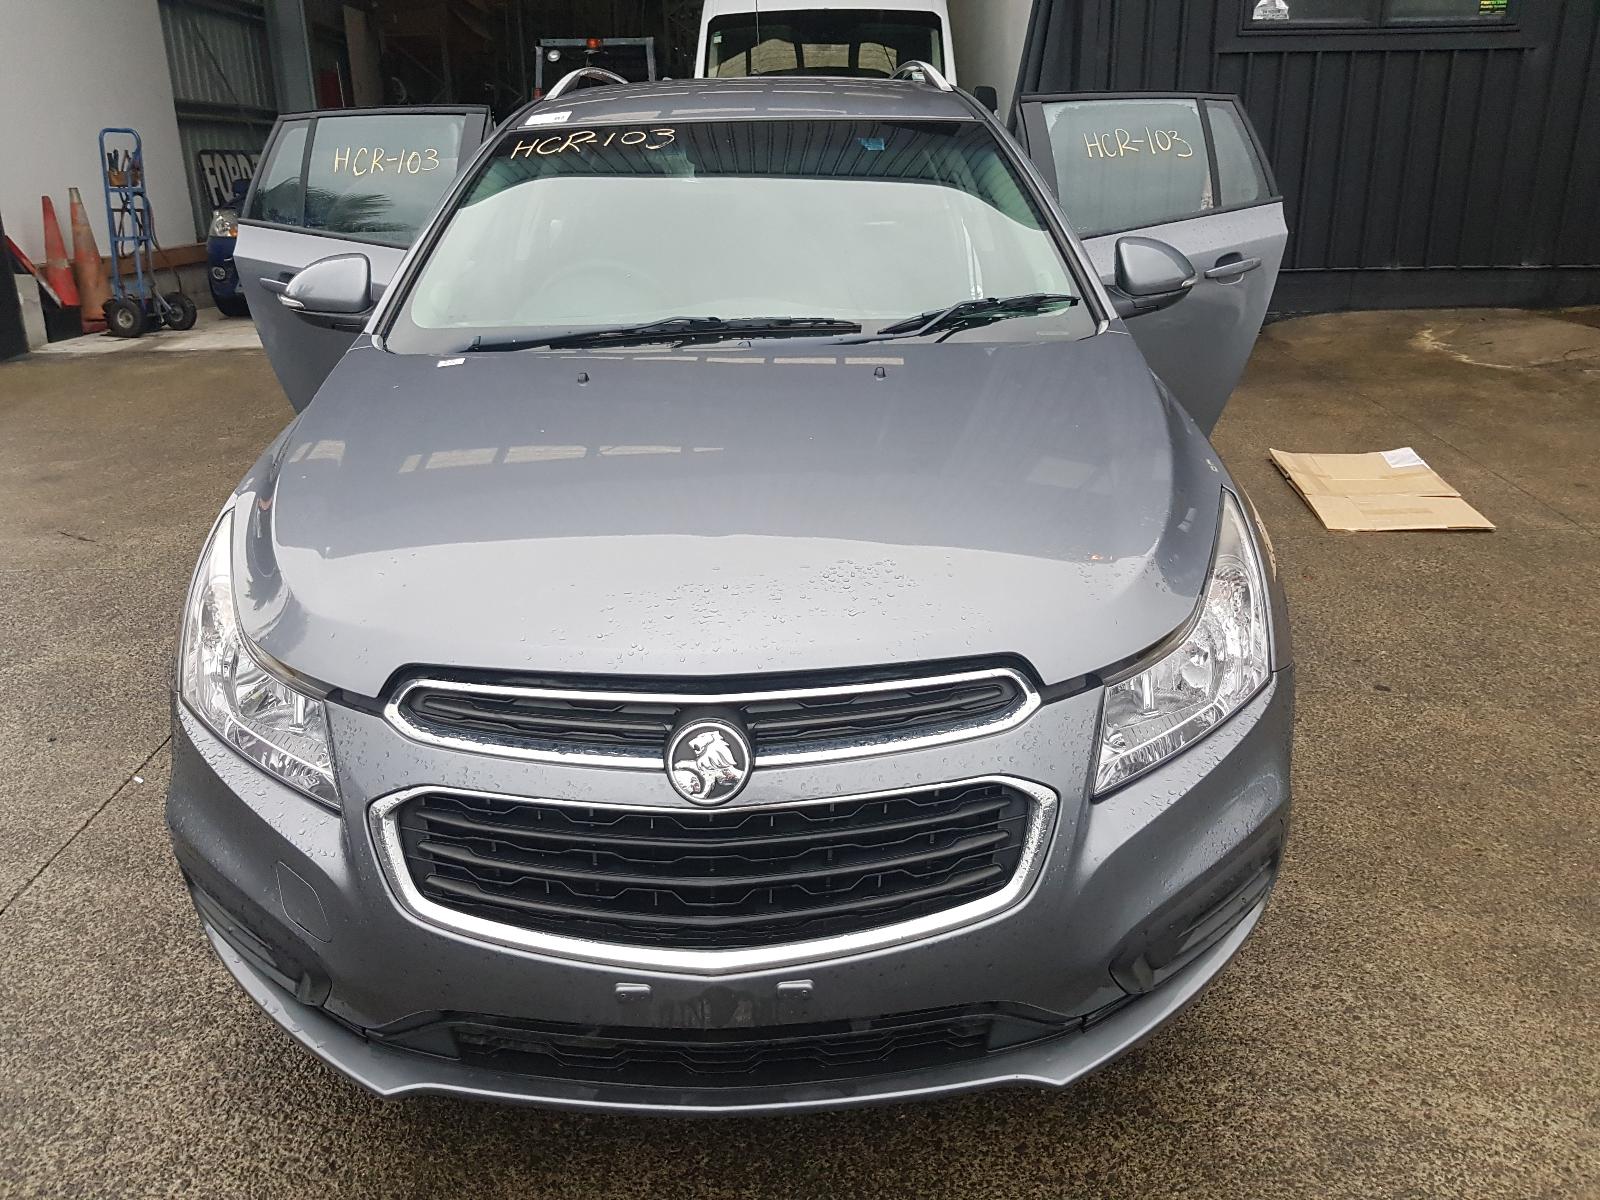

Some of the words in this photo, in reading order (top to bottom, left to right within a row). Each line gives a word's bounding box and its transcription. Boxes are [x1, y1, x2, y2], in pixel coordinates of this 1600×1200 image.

[510, 128, 676, 160] HCR-103
[1083, 126, 1193, 158] HCR-103
[333, 147, 441, 176] HCR-103
